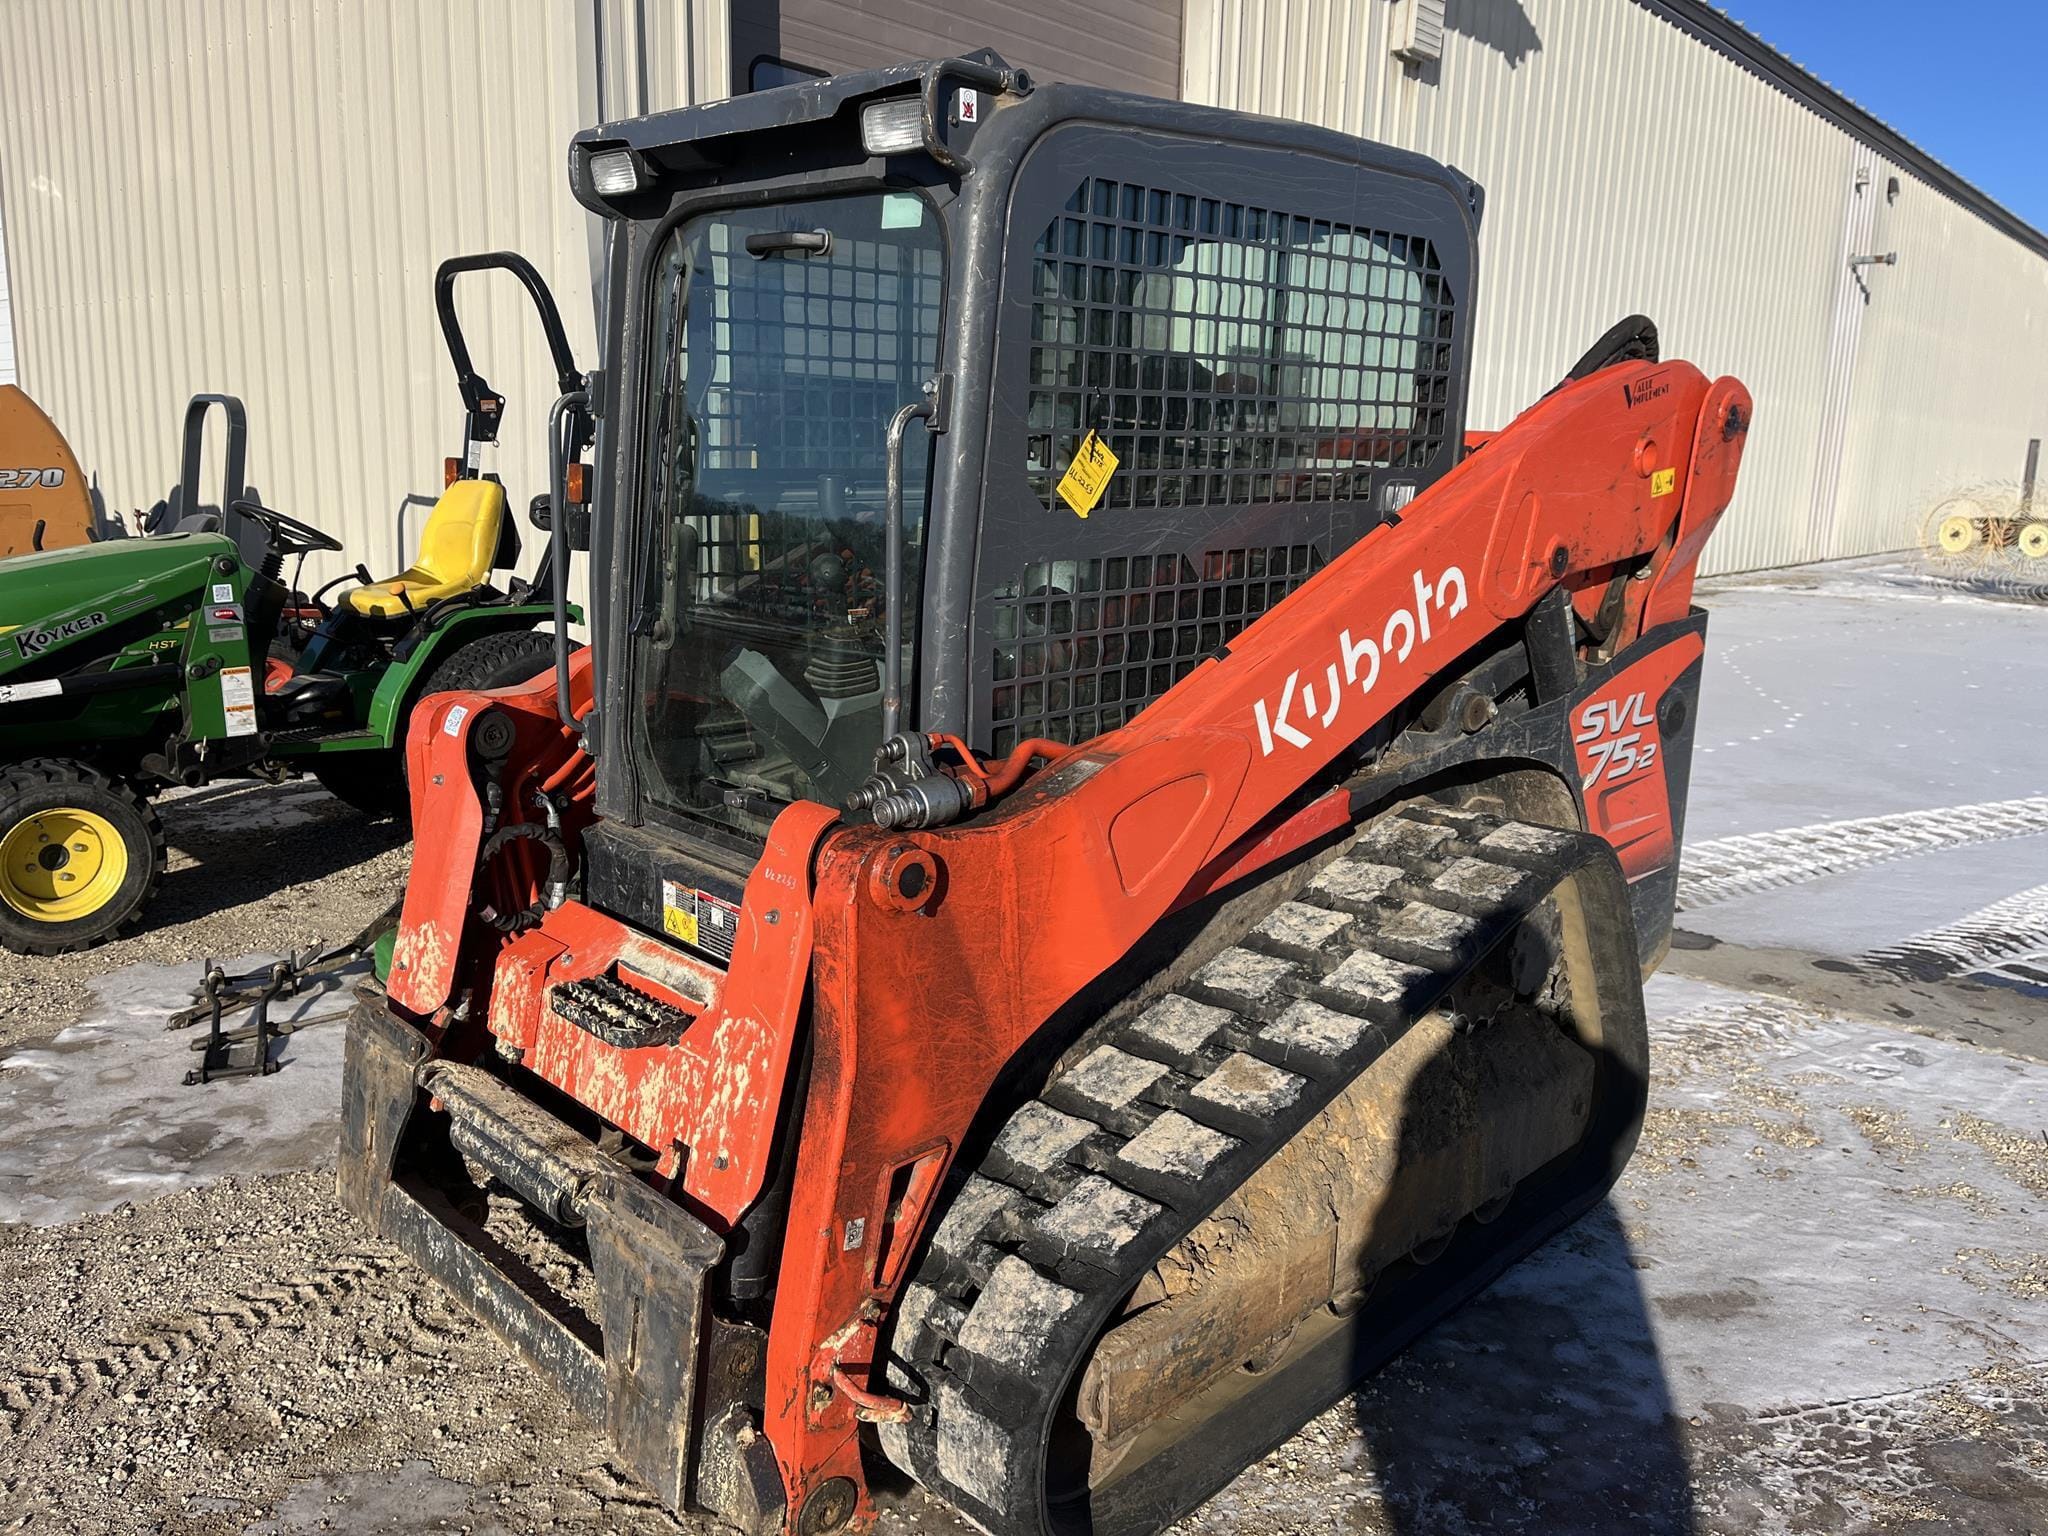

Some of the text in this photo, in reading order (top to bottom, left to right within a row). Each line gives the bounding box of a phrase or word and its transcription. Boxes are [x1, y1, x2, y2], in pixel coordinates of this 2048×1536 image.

[0, 467, 65, 489] 270
[149, 640, 178, 651] HST
[1253, 566, 1469, 758] Kubota
[1576, 691, 1655, 746] SVL
[1583, 732, 1657, 791] 75-2
